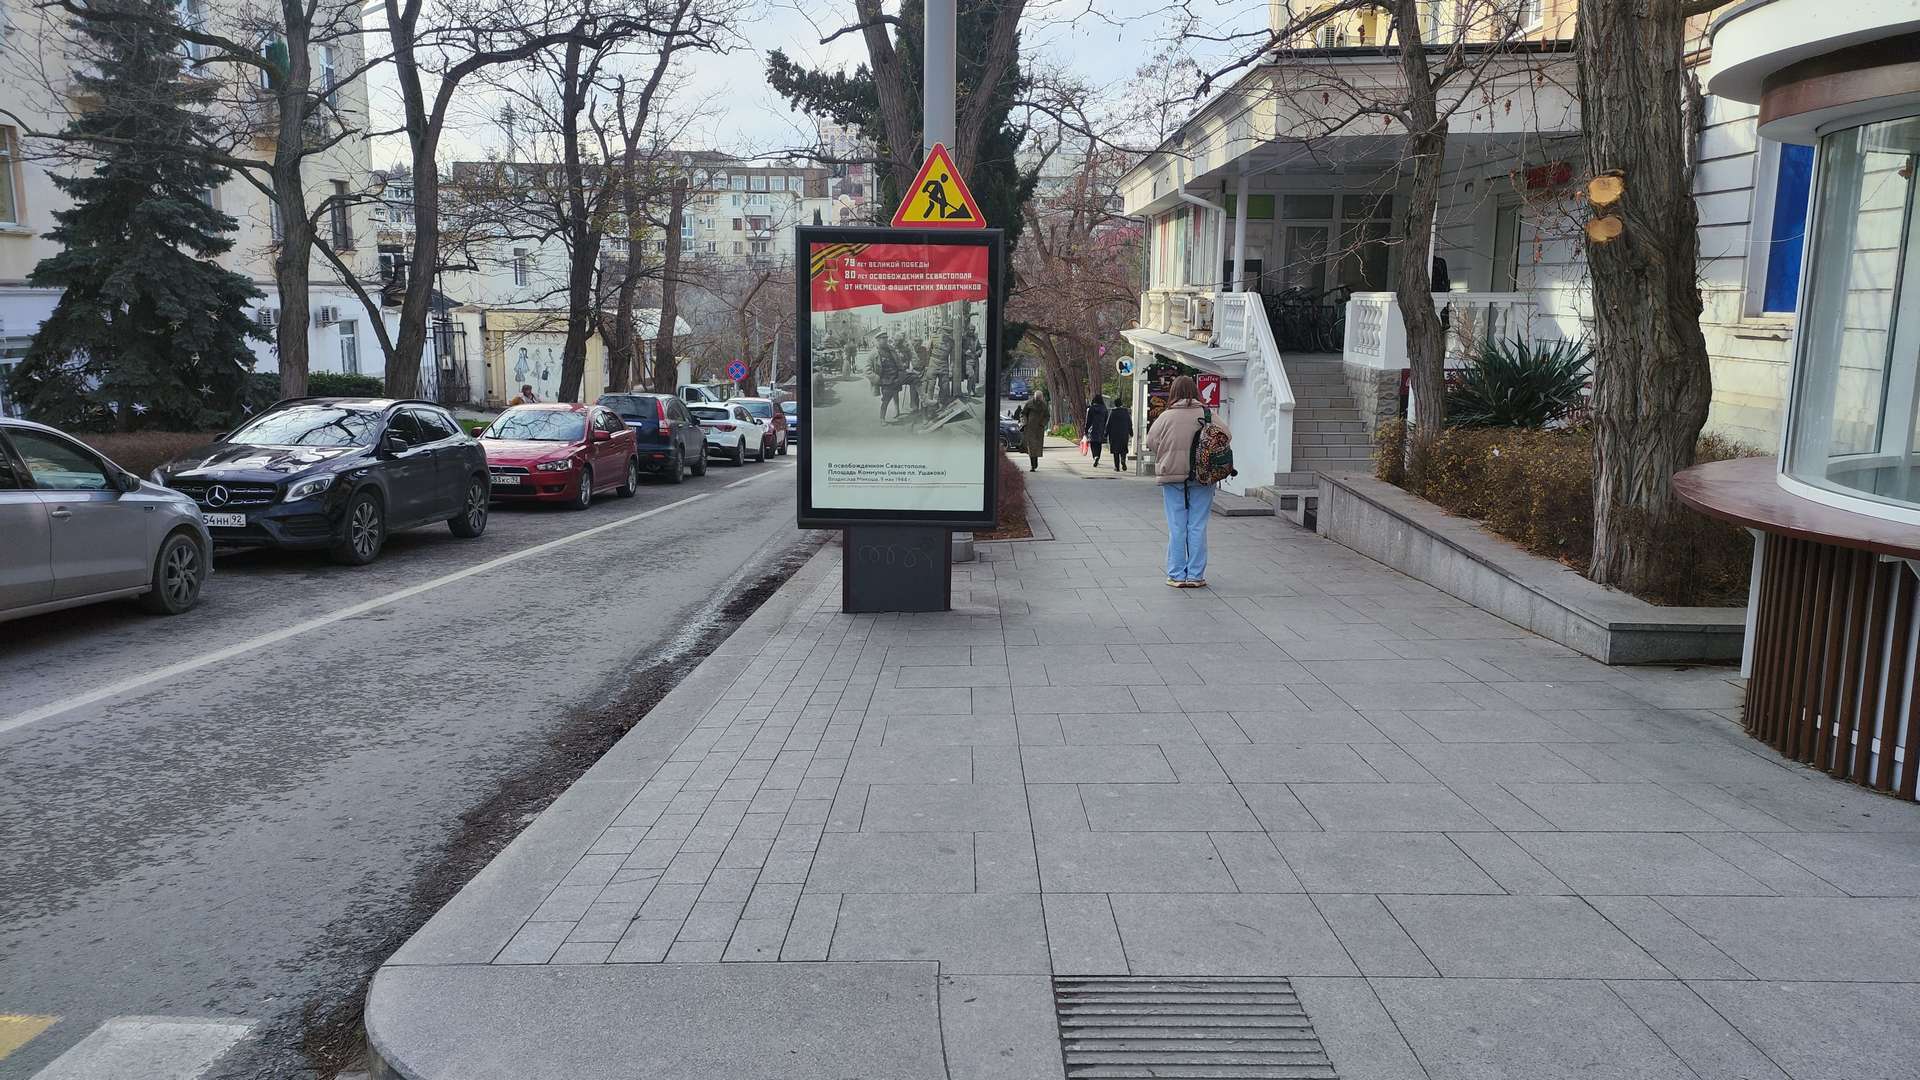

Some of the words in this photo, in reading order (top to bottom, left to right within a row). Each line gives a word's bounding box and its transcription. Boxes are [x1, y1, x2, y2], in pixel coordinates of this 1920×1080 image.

[844, 258, 855, 267] 79
[844, 270, 856, 279] 80
[231, 514, 242, 524] 92
